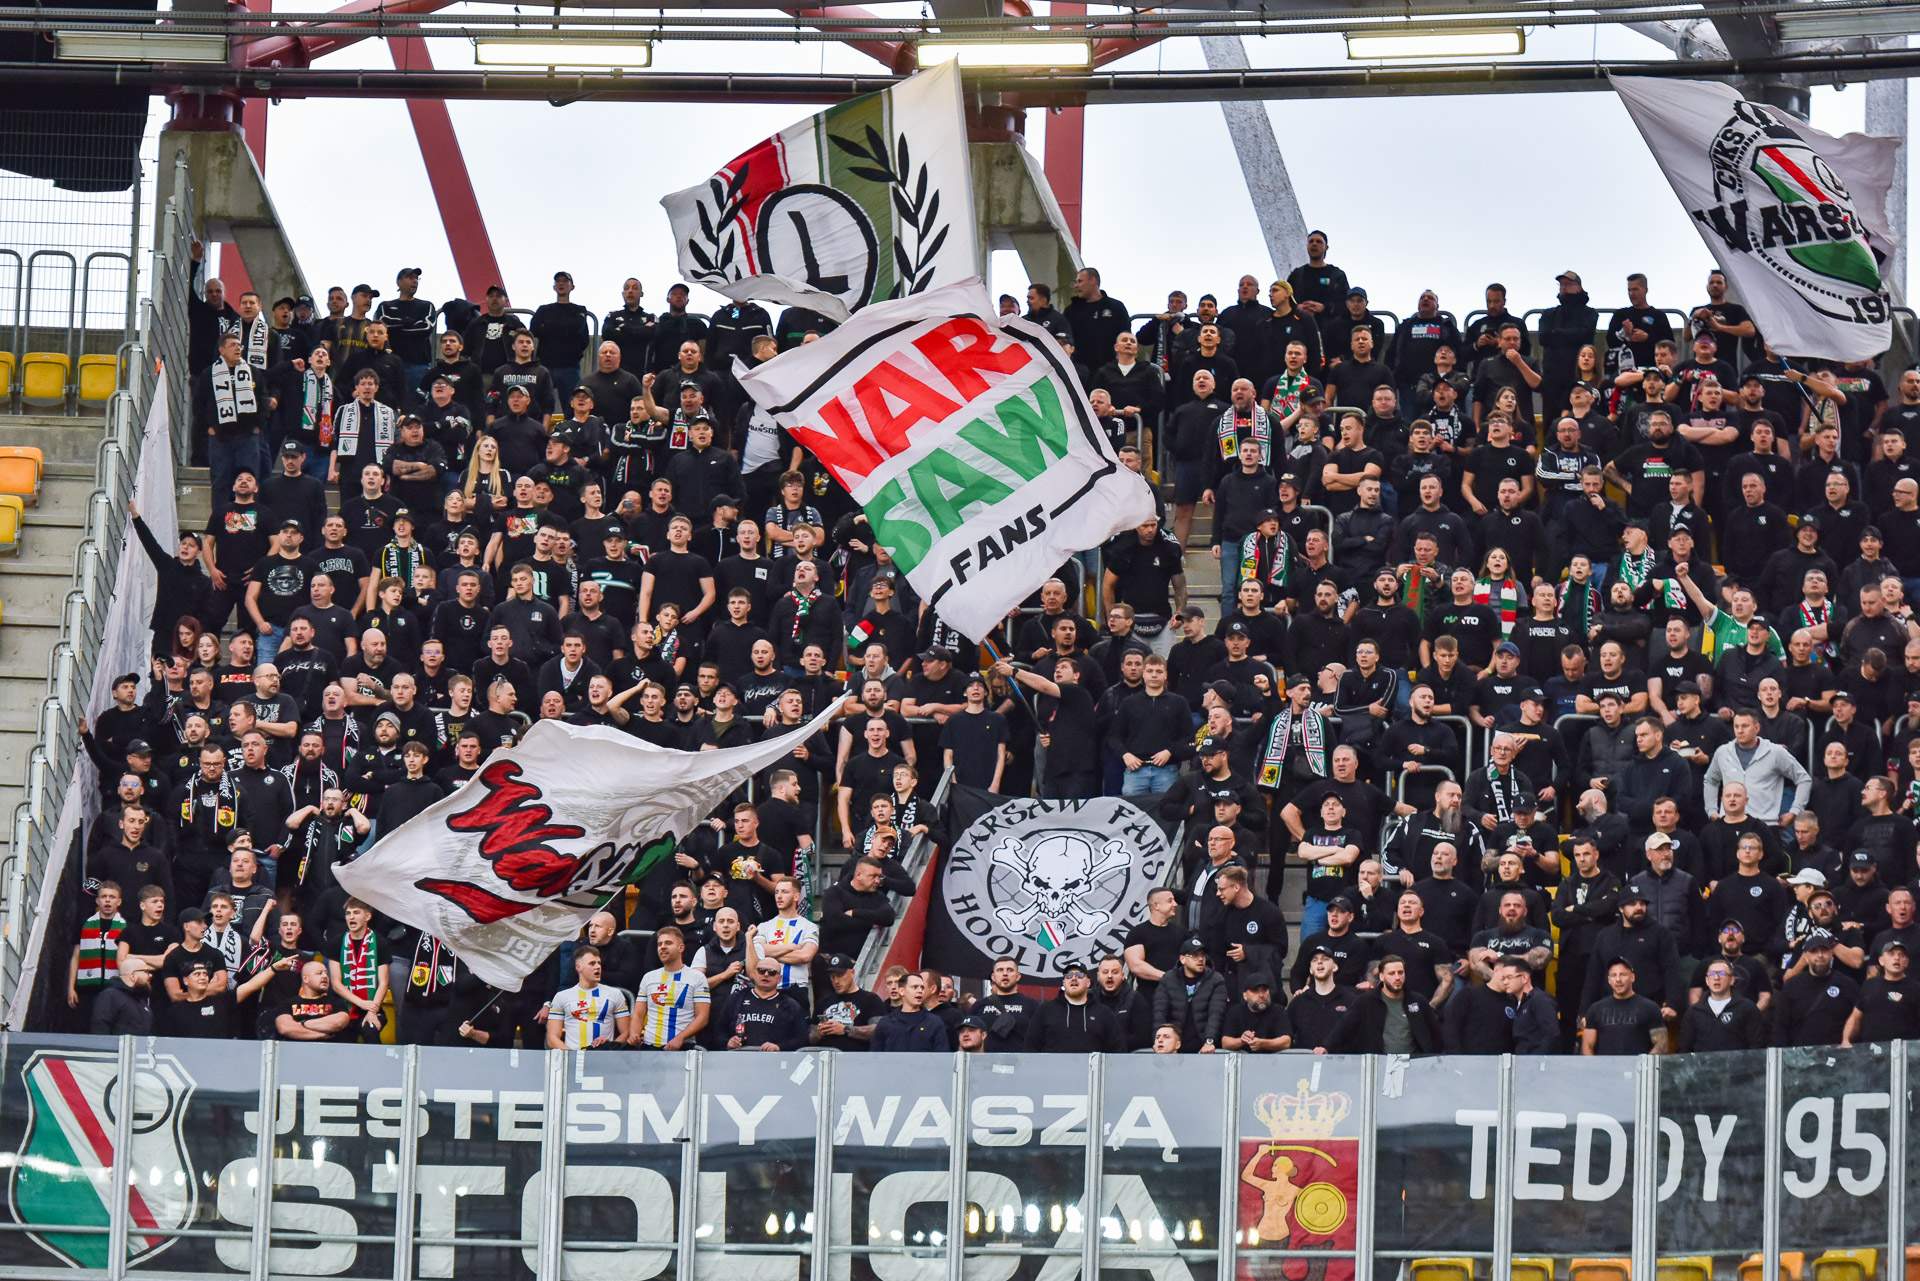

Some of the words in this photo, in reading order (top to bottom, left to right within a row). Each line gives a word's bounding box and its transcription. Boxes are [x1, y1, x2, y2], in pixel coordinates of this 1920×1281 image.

[863, 375, 1069, 577] SAW
[319, 557, 354, 574] LEGIA
[950, 504, 1047, 584] FANS
[951, 798, 1090, 874] WARSAW
[1107, 804, 1166, 881] FANS
[951, 892, 1149, 974] HOOLIGANS
[244, 1076, 783, 1146] JESTEŚMY
[812, 1094, 1179, 1164] WASZĄ
[1455, 1109, 1738, 1202] TEDDY
[1782, 1092, 1891, 1199] 95
